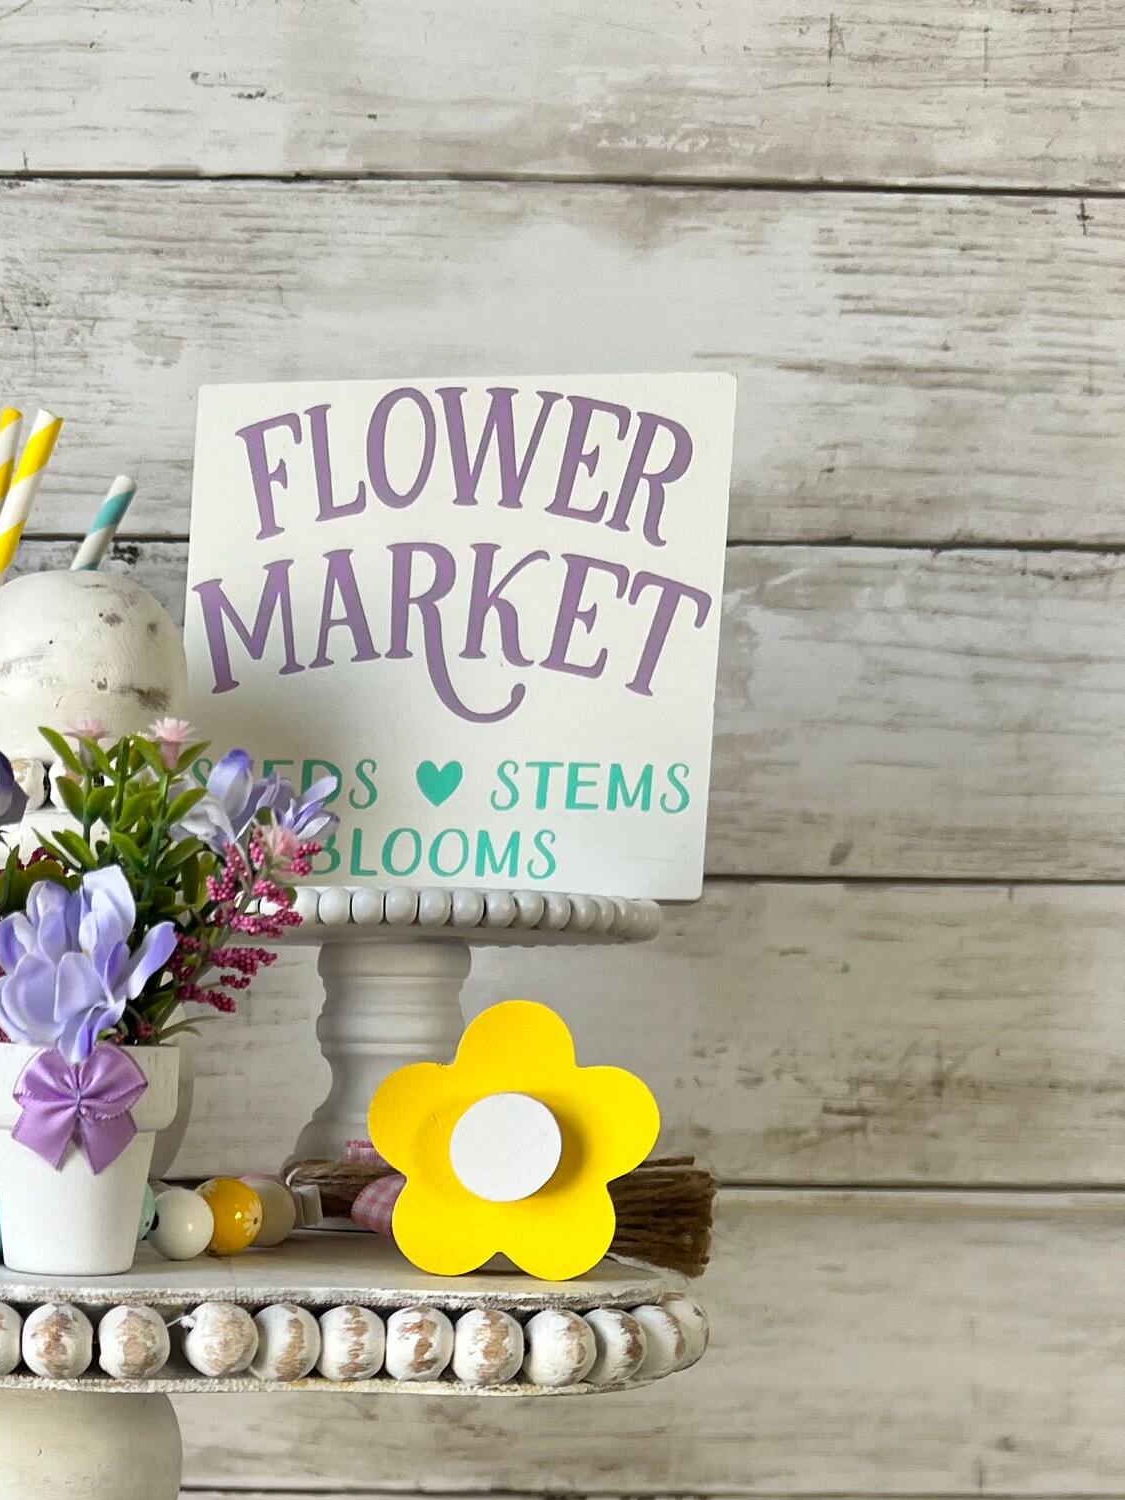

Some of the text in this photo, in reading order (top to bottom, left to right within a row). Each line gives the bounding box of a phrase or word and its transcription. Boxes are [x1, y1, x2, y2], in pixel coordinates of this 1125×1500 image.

[235, 386, 694, 547] FLOWER
[191, 541, 712, 724] MARKET
[490, 759, 690, 815] STEMS
